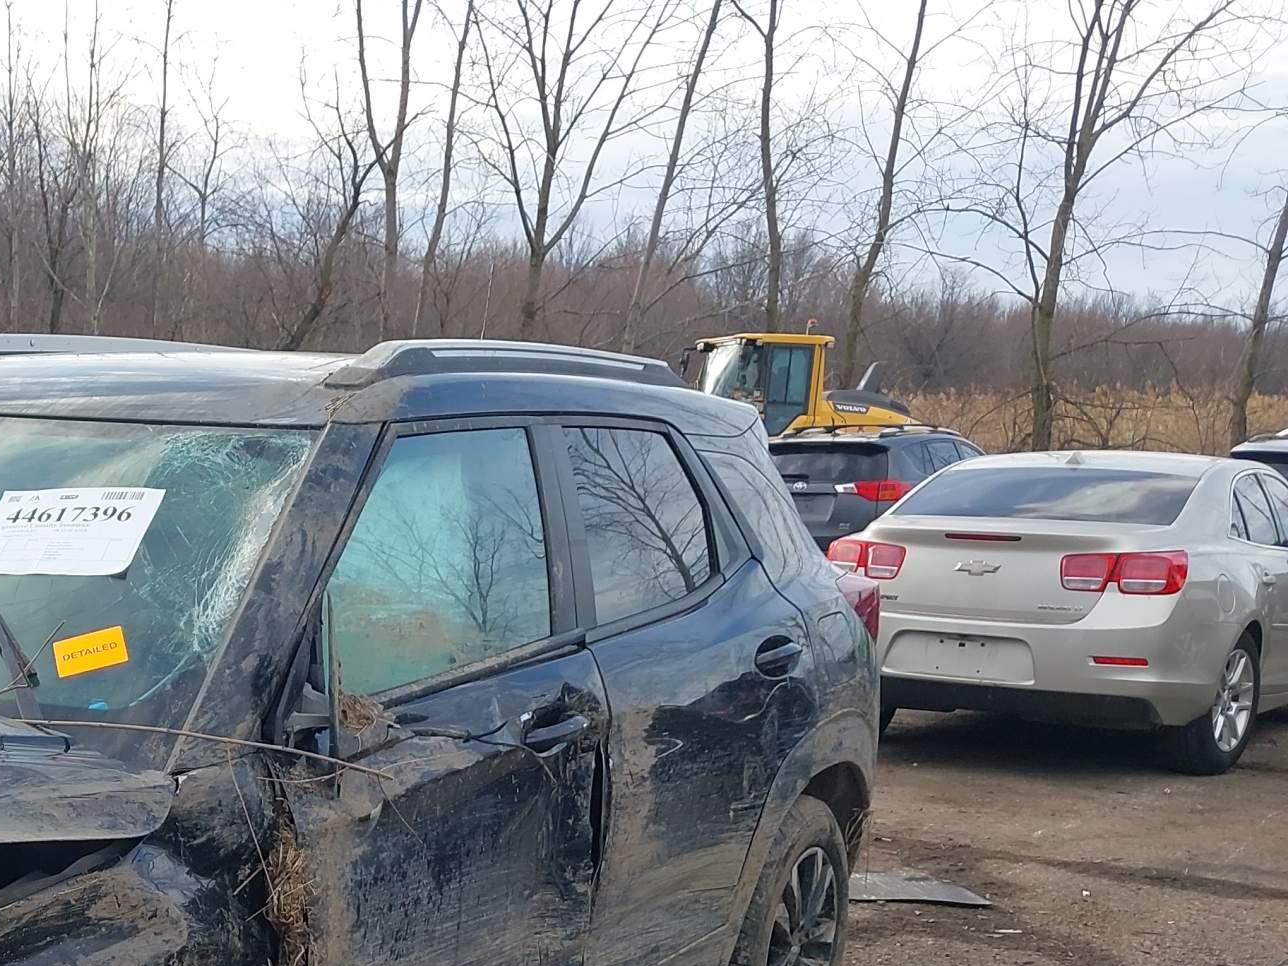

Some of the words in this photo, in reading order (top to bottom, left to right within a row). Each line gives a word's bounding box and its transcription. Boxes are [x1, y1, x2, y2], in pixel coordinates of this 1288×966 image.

[835, 403, 867, 413] VOLVO
[6, 505, 136, 523] 44617396
[62, 641, 118, 662] DETAILED
